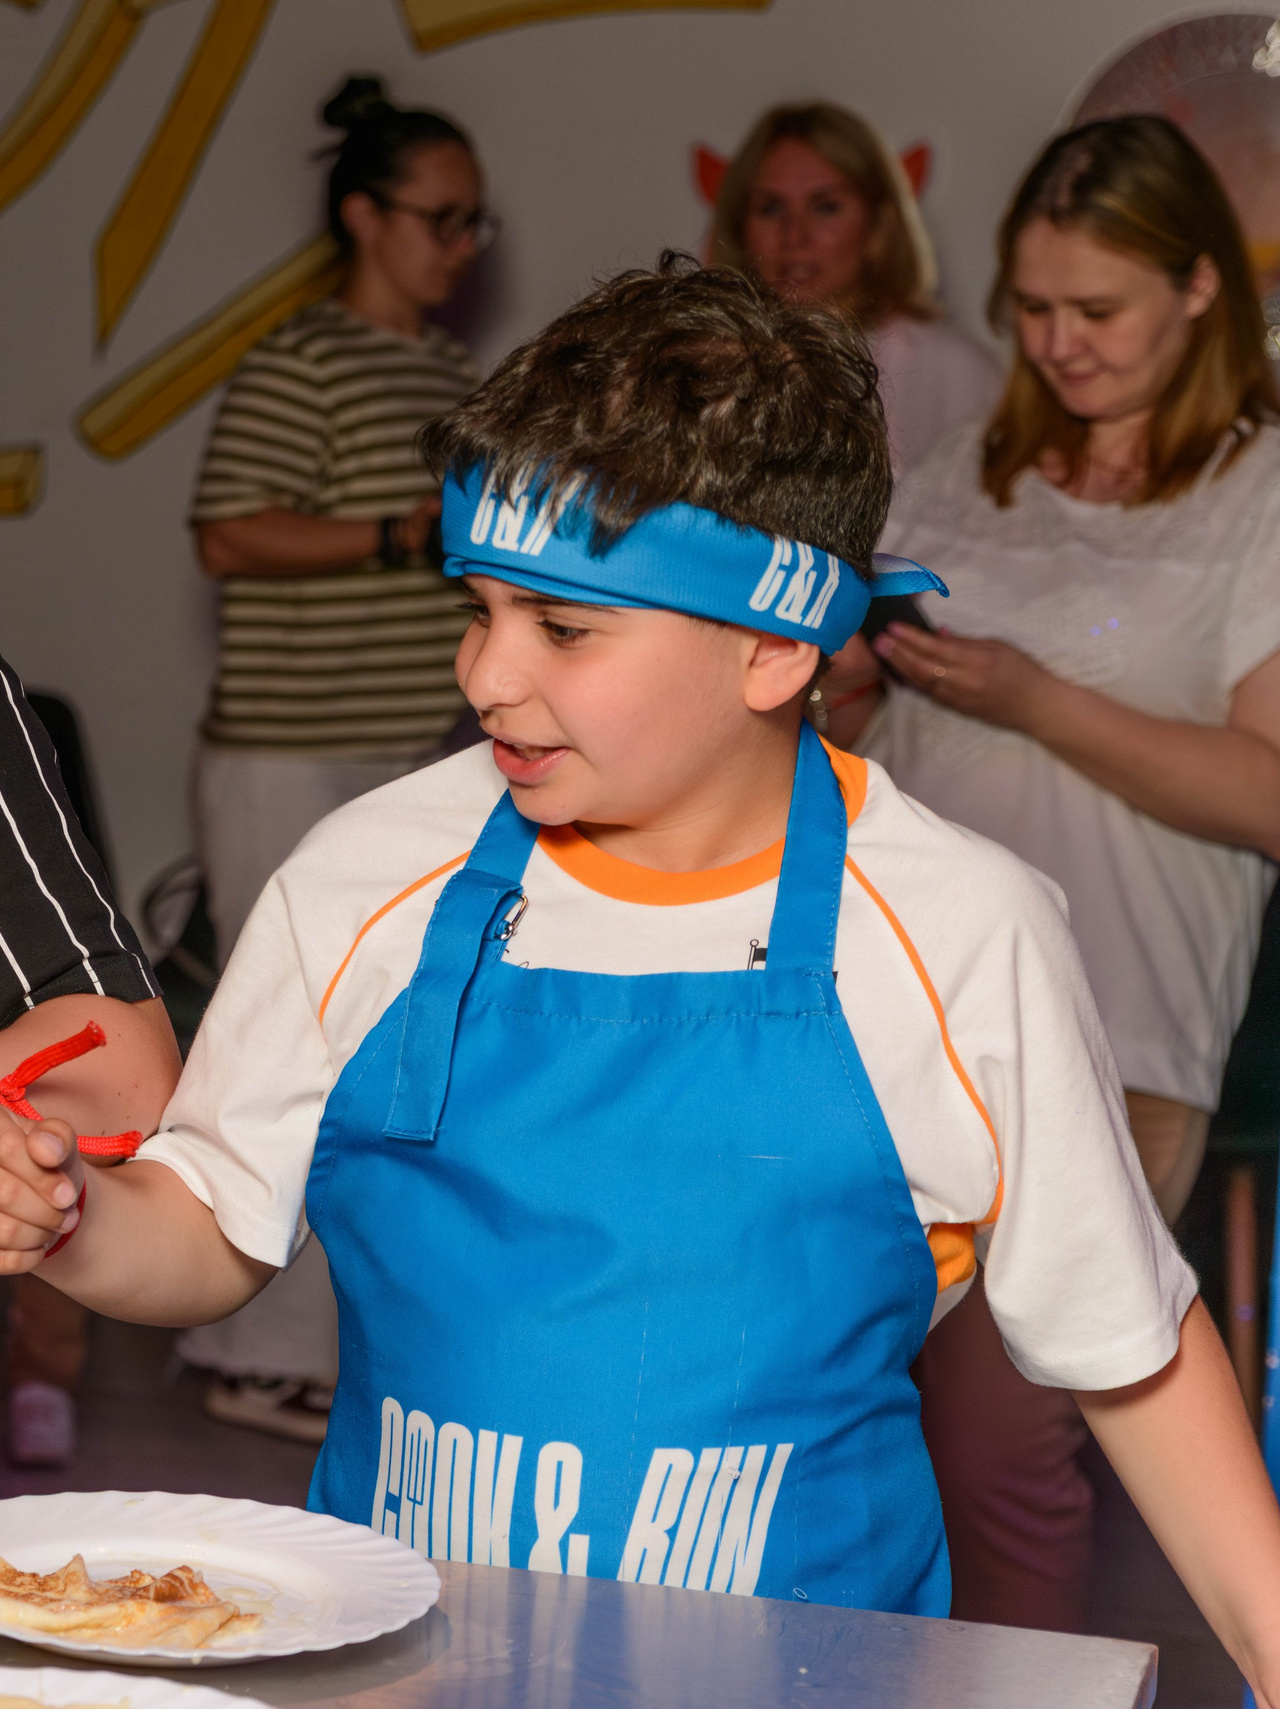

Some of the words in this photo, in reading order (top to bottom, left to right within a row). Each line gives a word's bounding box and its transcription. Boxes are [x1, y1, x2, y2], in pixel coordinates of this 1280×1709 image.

[749, 533, 840, 630] C&R
[371, 1396, 524, 1568] COOK
[527, 1441, 591, 1578] &
[616, 1442, 795, 1597] RUN
